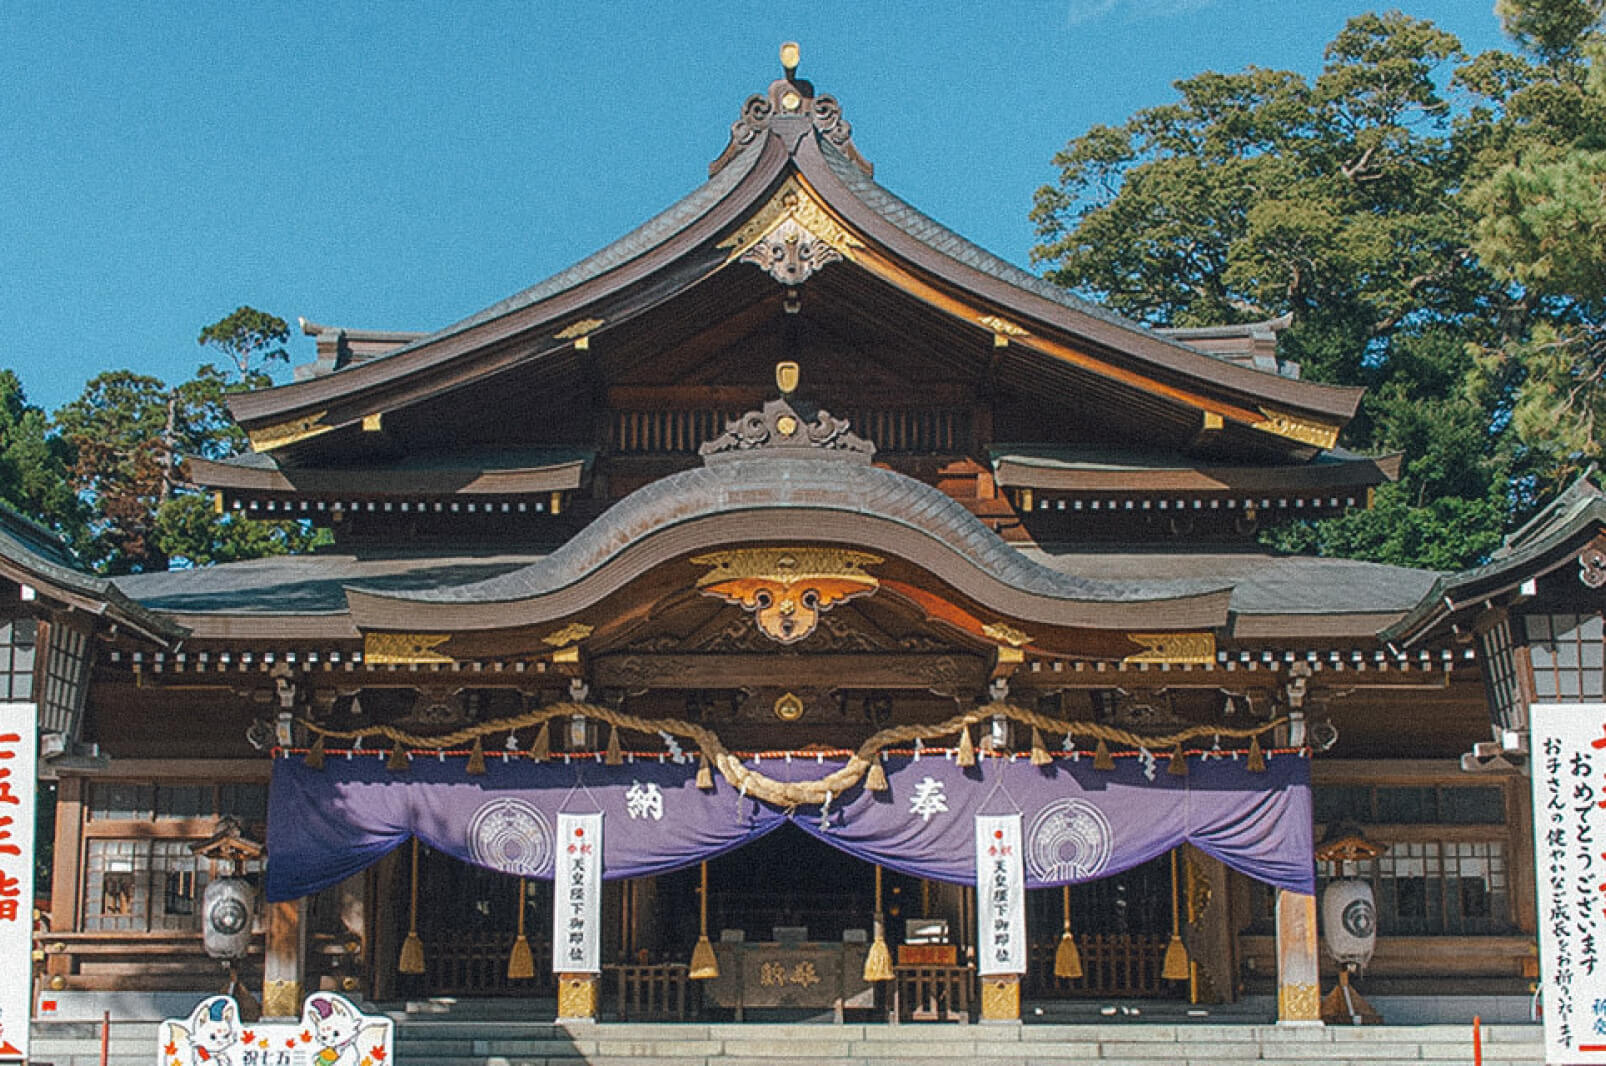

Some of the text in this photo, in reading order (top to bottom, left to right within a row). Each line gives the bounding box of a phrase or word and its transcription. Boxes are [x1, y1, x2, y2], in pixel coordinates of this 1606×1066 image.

[625, 779, 664, 821] 納
[909, 777, 949, 821] 奉
[568, 857, 585, 961] 天皇陛下御即位
[992, 859, 1010, 962] 天皇陛下御即位
[1569, 750, 1599, 976] おめでとうございます
